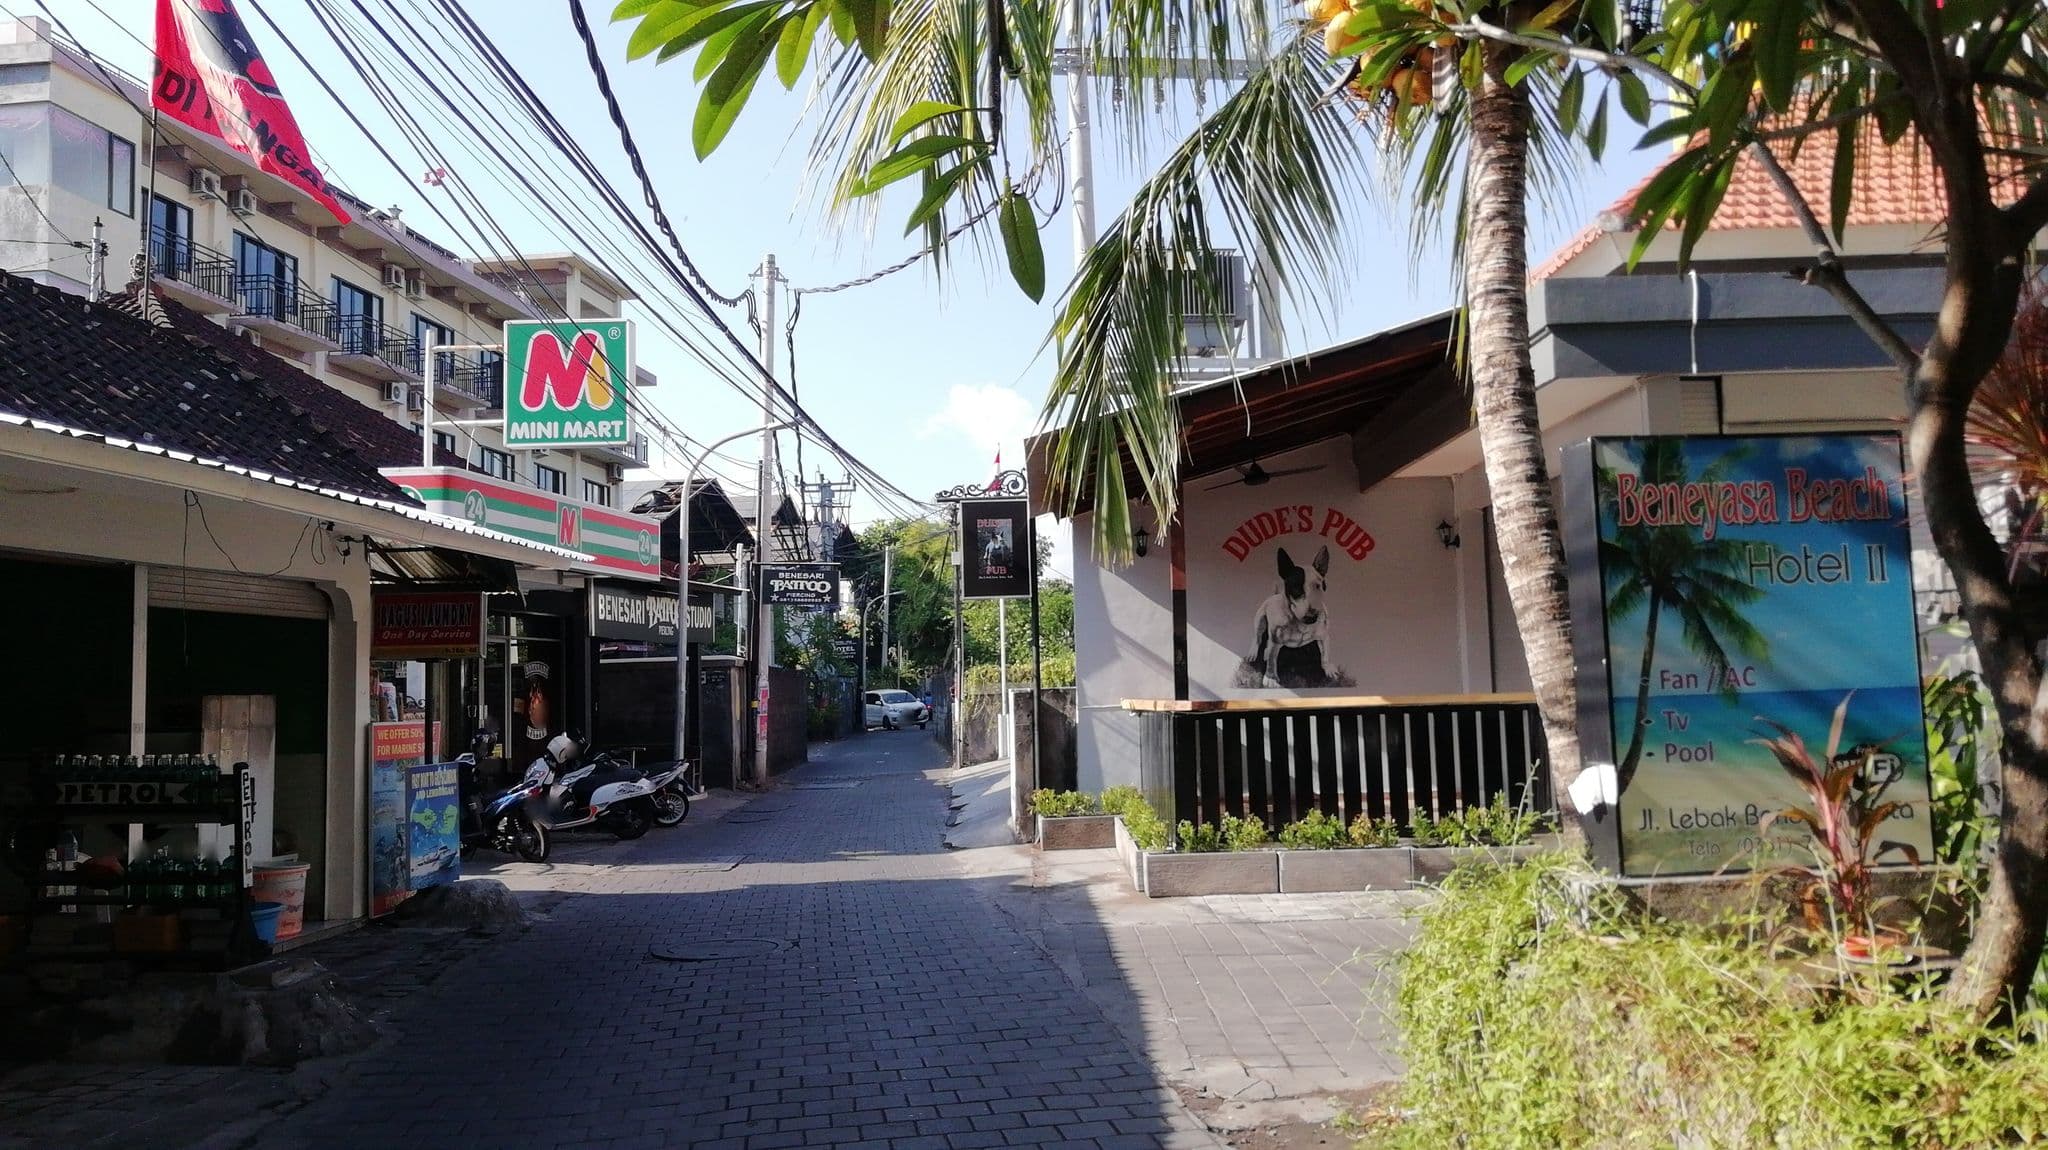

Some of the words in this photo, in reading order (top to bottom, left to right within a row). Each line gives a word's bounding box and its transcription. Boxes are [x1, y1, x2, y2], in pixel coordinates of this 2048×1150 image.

[510, 421, 559, 439] MINI
[563, 420, 623, 438] MART
[467, 496, 485, 522] 24
[1616, 472, 1779, 541] Beneyasa
[1784, 465, 1891, 523] Beach
[1222, 505, 1313, 563] DUDE'S
[1319, 507, 1375, 561] PUB
[985, 566, 1007, 575] PUB
[1747, 543, 1850, 585] Hotel
[598, 593, 645, 624] BENESARI
[685, 605, 712, 629] STUDIO
[382, 630, 402, 640] One
[407, 629, 428, 641] Day
[431, 628, 472, 641] Service
[1660, 669, 1698, 690] Fan
[1725, 666, 1757, 687] AC
[1663, 710, 1690, 731] Tv
[377, 729, 388, 740] WE
[389, 728, 409, 740] OFFER
[377, 745, 391, 756] FOR
[391, 743, 417, 755] MARINE
[1665, 742, 1715, 763] Pool
[65, 783, 174, 803] PETROL
[242, 771, 252, 874] PETROL
[1669, 806, 1737, 830] Lebak
